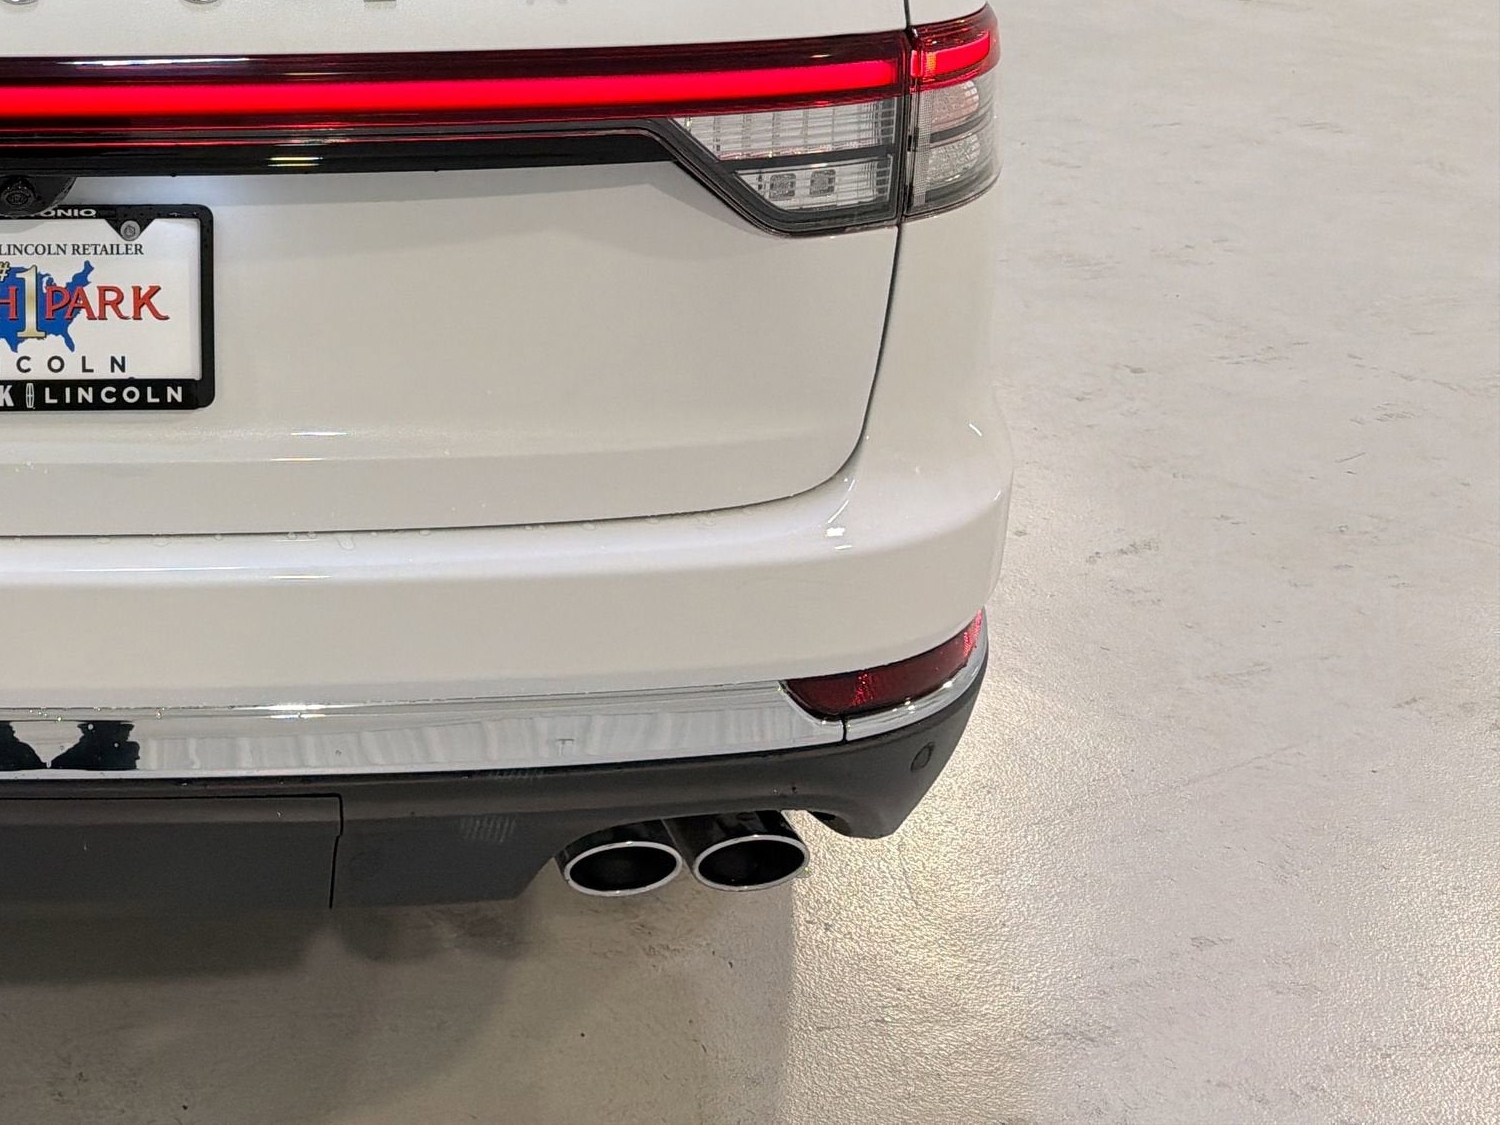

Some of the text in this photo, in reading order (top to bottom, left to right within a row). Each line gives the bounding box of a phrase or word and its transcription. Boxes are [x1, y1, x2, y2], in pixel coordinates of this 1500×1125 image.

[71, 242, 144, 256] RETAILER
[44, 285, 170, 321] PARK
[44, 385, 183, 404] LINCOLN
